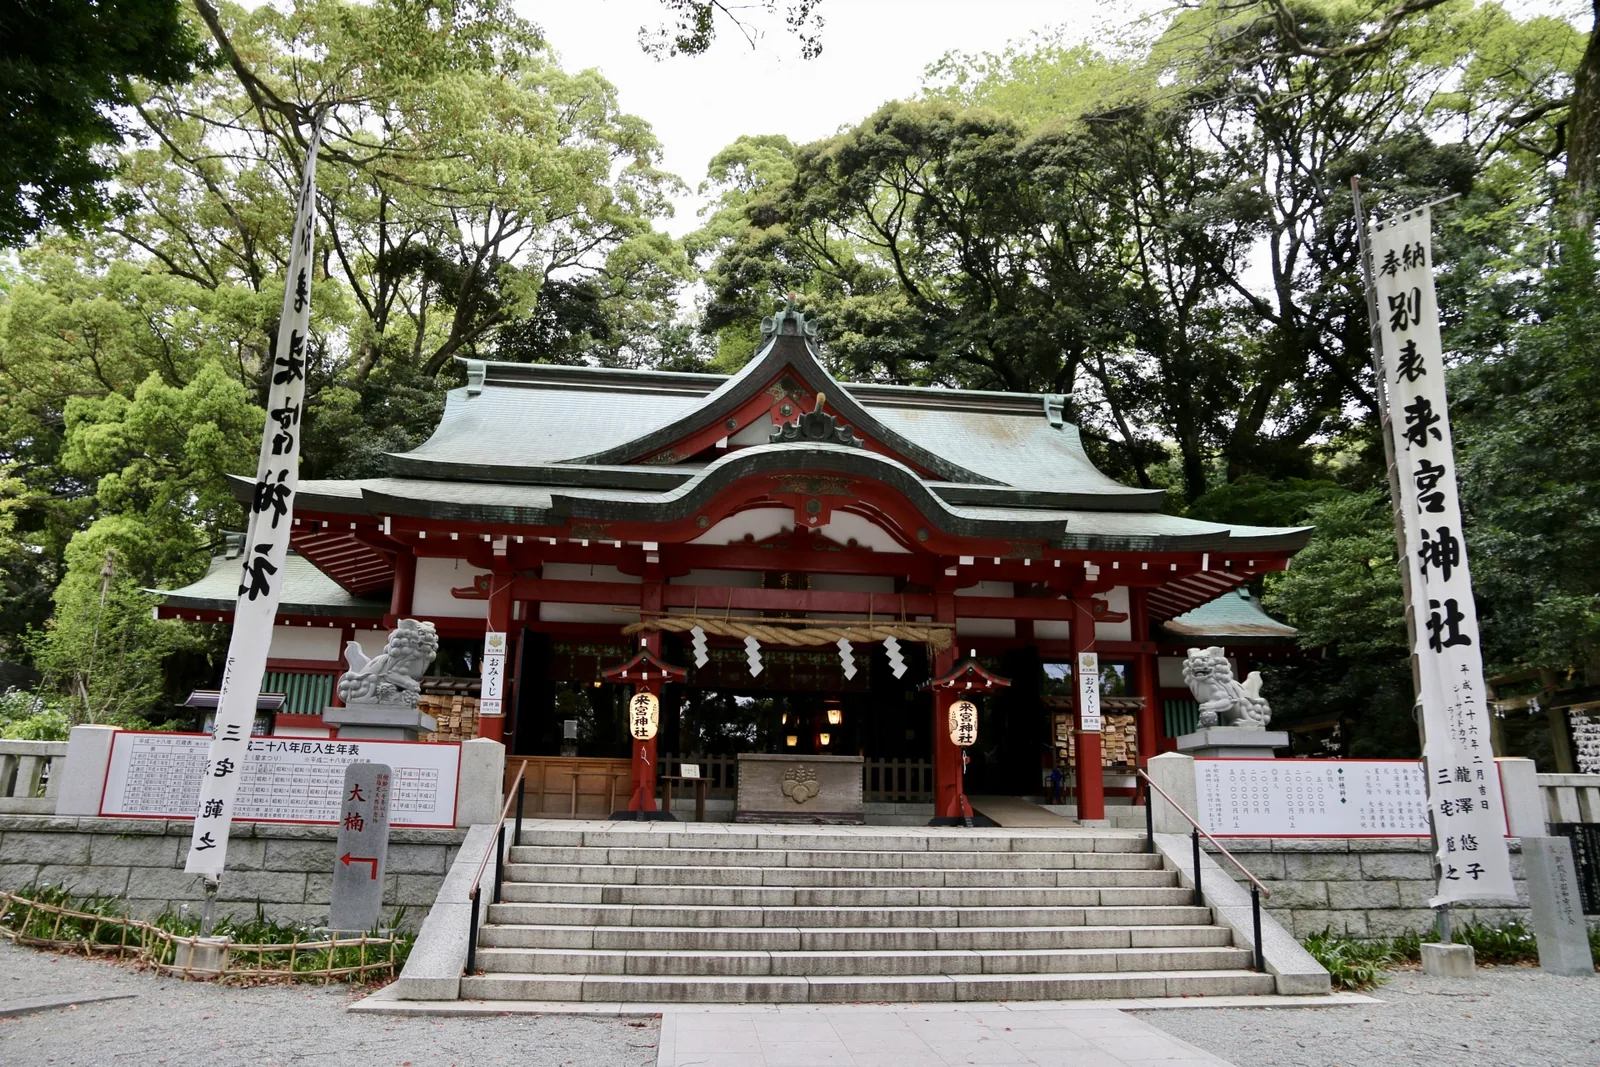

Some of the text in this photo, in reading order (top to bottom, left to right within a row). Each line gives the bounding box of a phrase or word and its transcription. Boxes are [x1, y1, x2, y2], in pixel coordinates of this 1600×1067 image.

[1379, 241, 1426, 280] 奉納
[1387, 286, 1472, 654] 別表来宮神社
[488, 658, 499, 696] おみくじ
[1085, 677, 1094, 714] おみくじ
[634, 694, 650, 737] 来宮神社
[958, 703, 973, 744] 来宮神社
[1460, 664, 1490, 810] 平成二十六年二月吉日
[344, 784, 366, 832] 大楠
[1454, 766, 1486, 880] 瀧澤悠子
